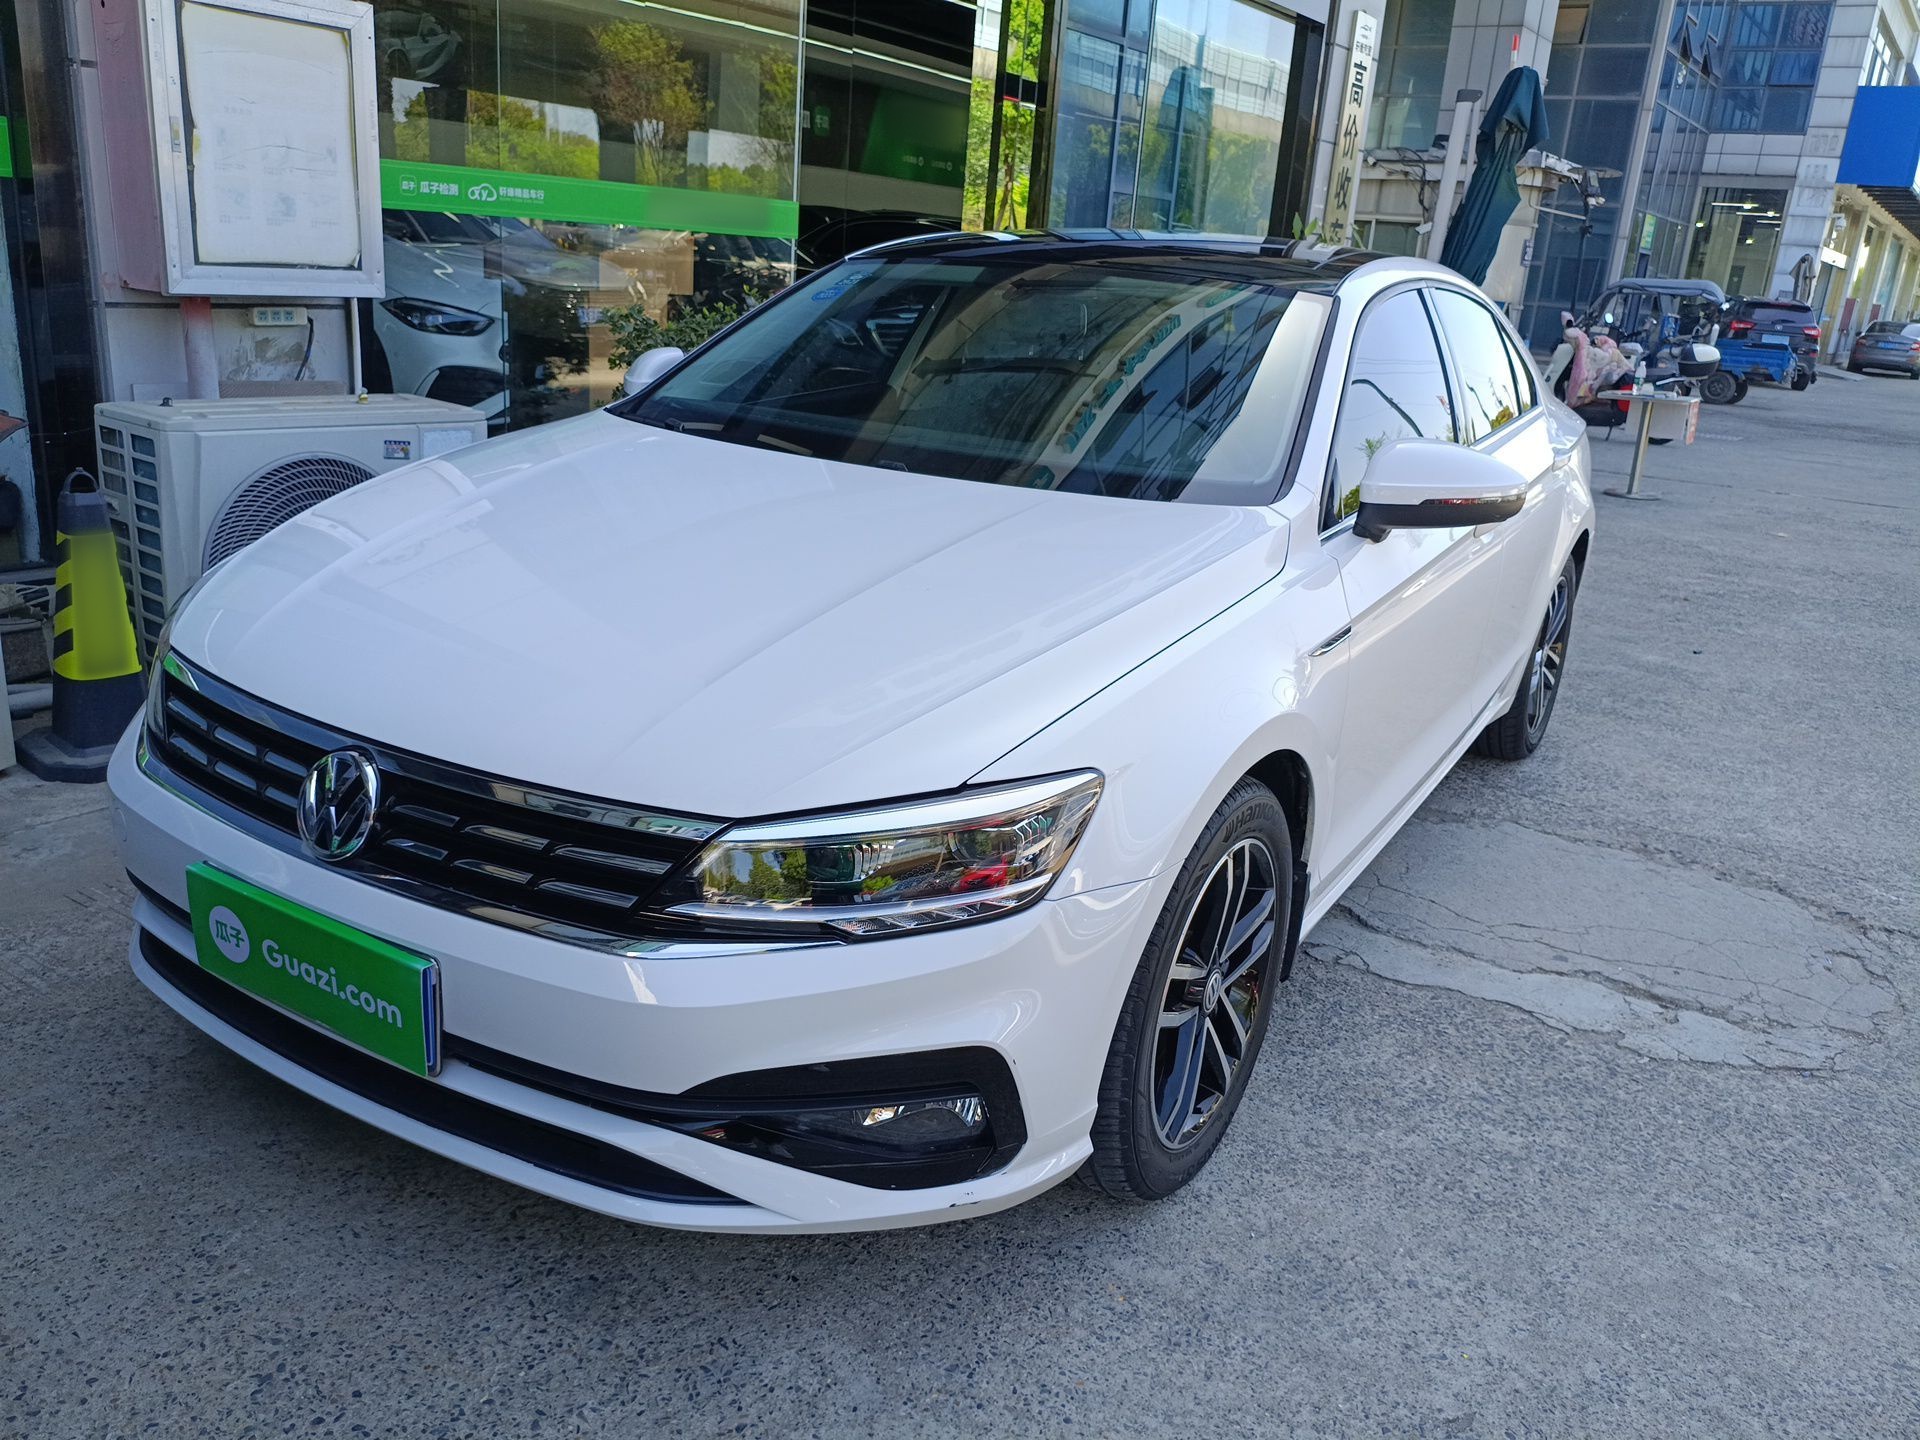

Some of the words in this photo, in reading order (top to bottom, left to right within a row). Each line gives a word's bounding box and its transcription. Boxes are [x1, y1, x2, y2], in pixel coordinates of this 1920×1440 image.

[419, 181, 459, 196] 瓜子检测
[215, 919, 245, 949] 瓜子
[261, 938, 403, 1028] Guazi.com
